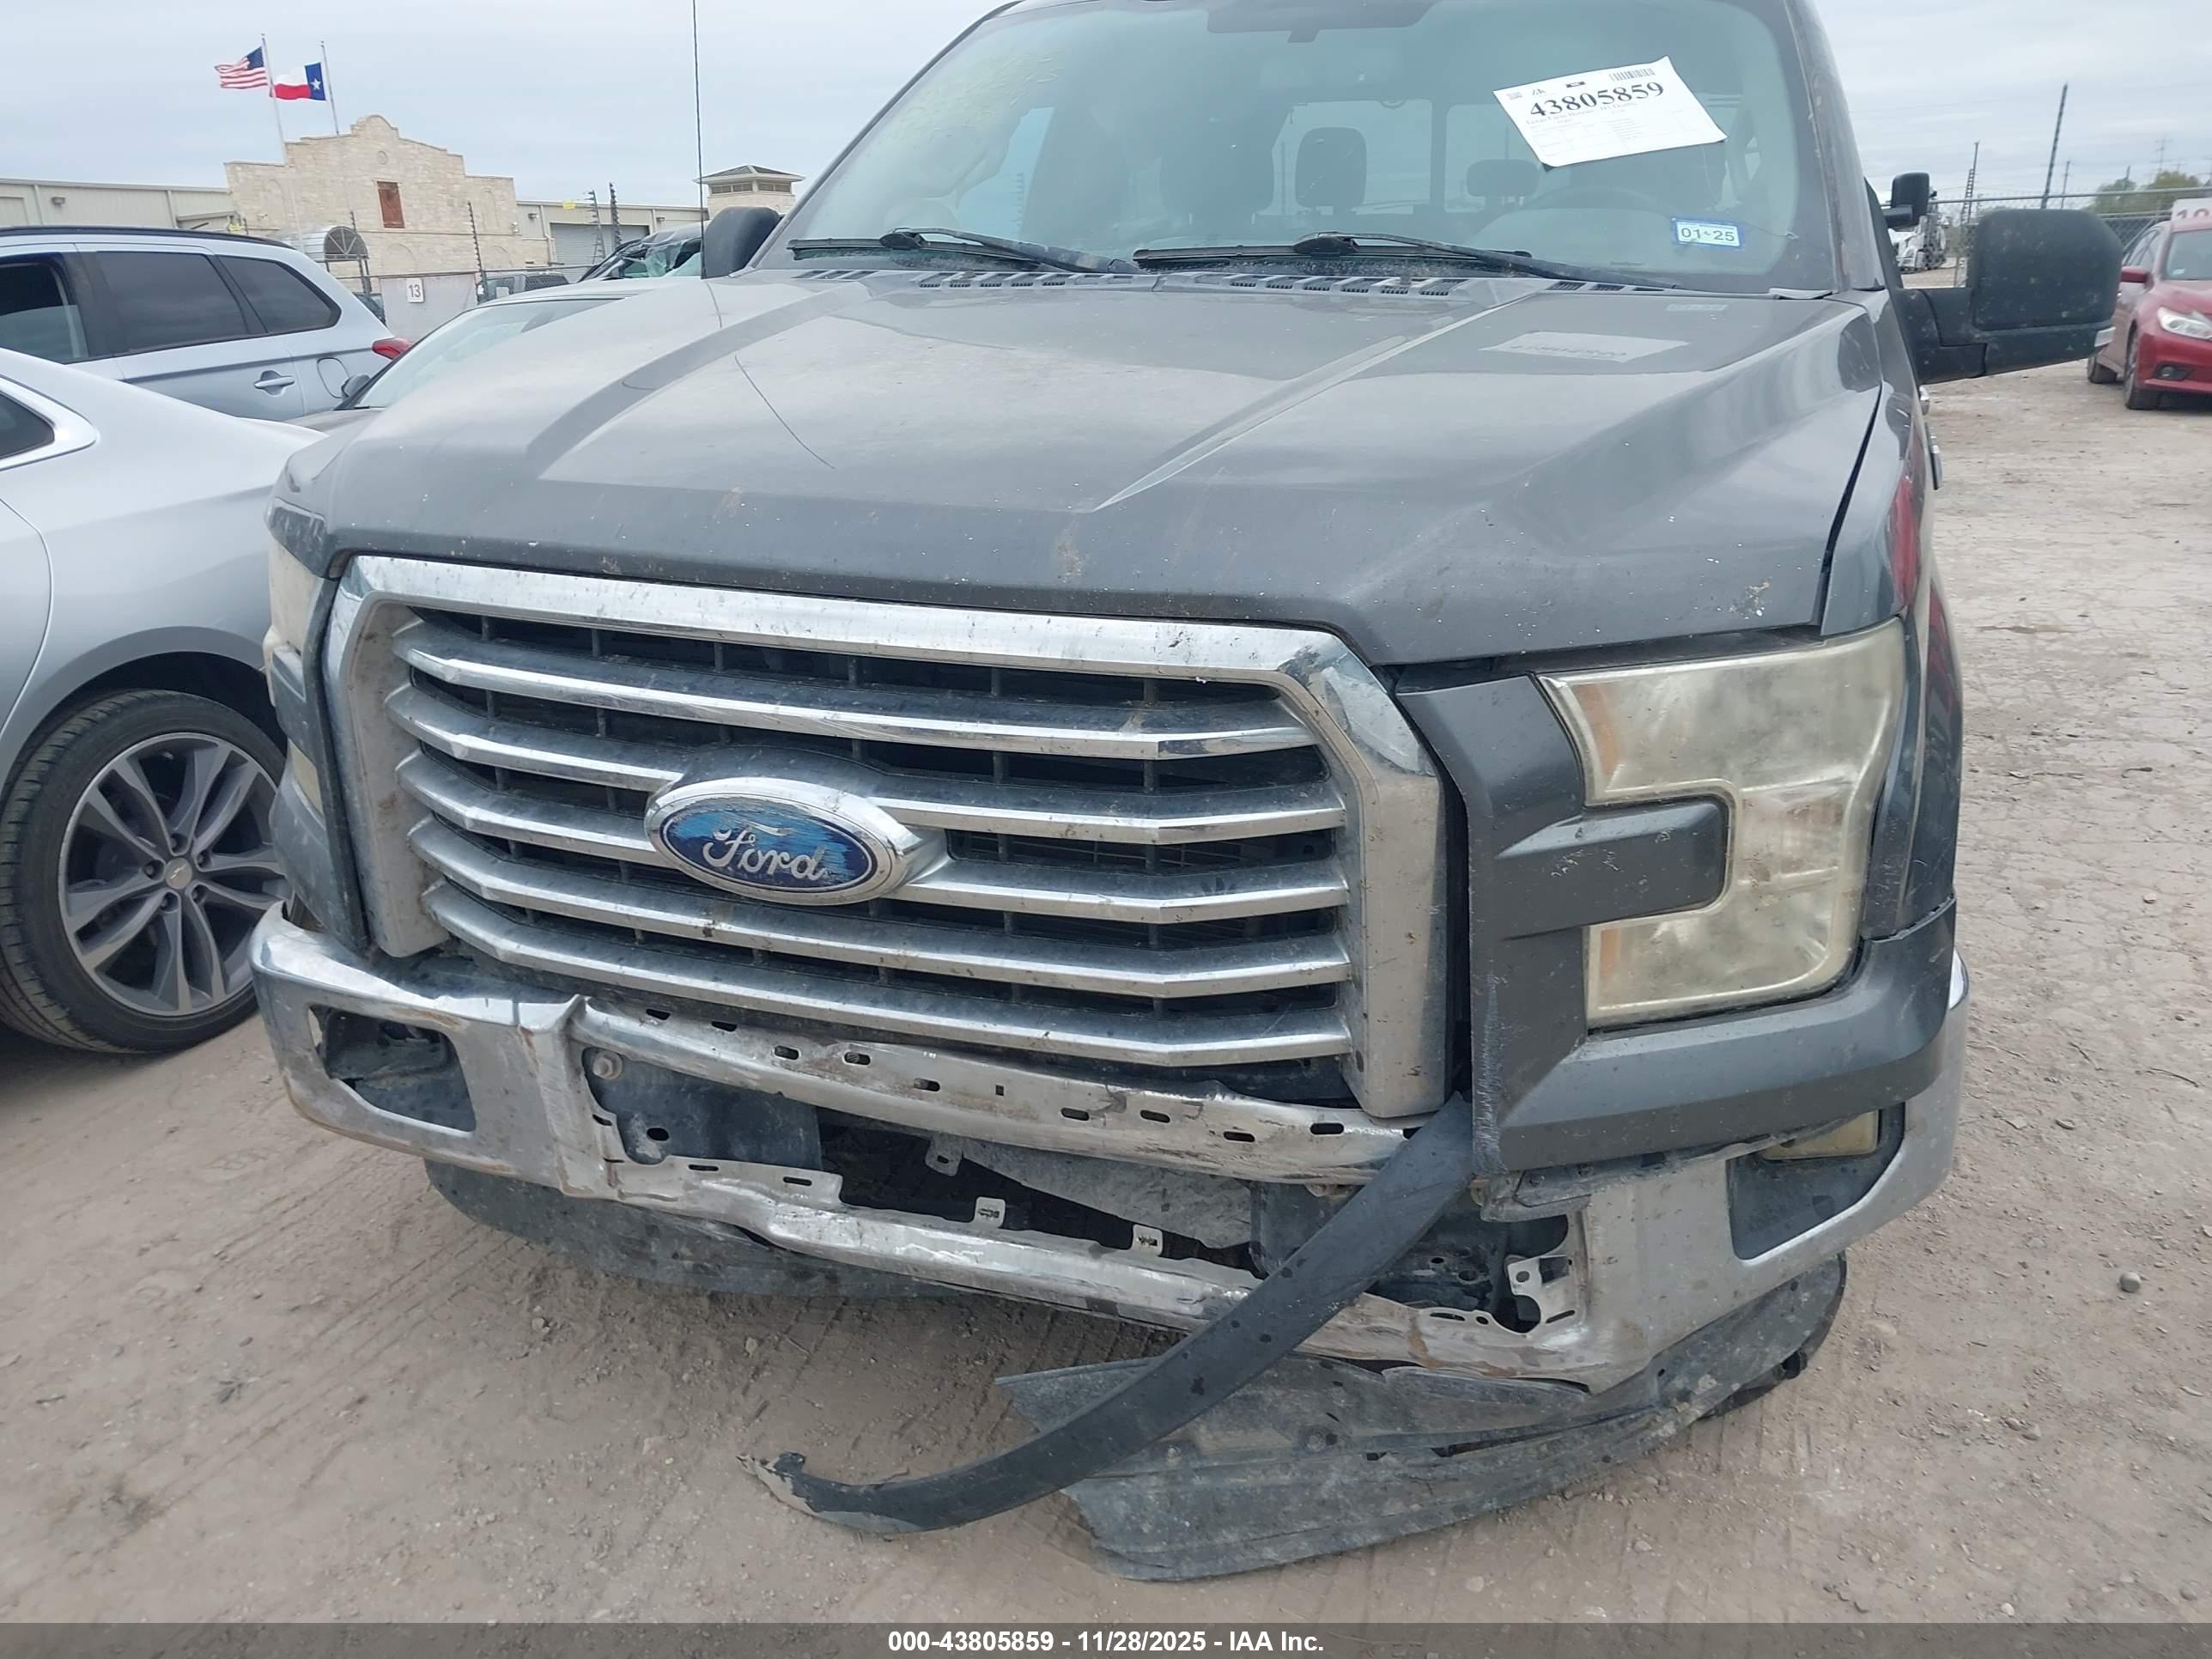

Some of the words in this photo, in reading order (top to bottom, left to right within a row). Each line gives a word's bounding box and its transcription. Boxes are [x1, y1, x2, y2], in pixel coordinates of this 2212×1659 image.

[1529, 82, 1664, 117] 43805859
[408, 283, 421, 298] 13
[702, 816, 828, 881] Ford
